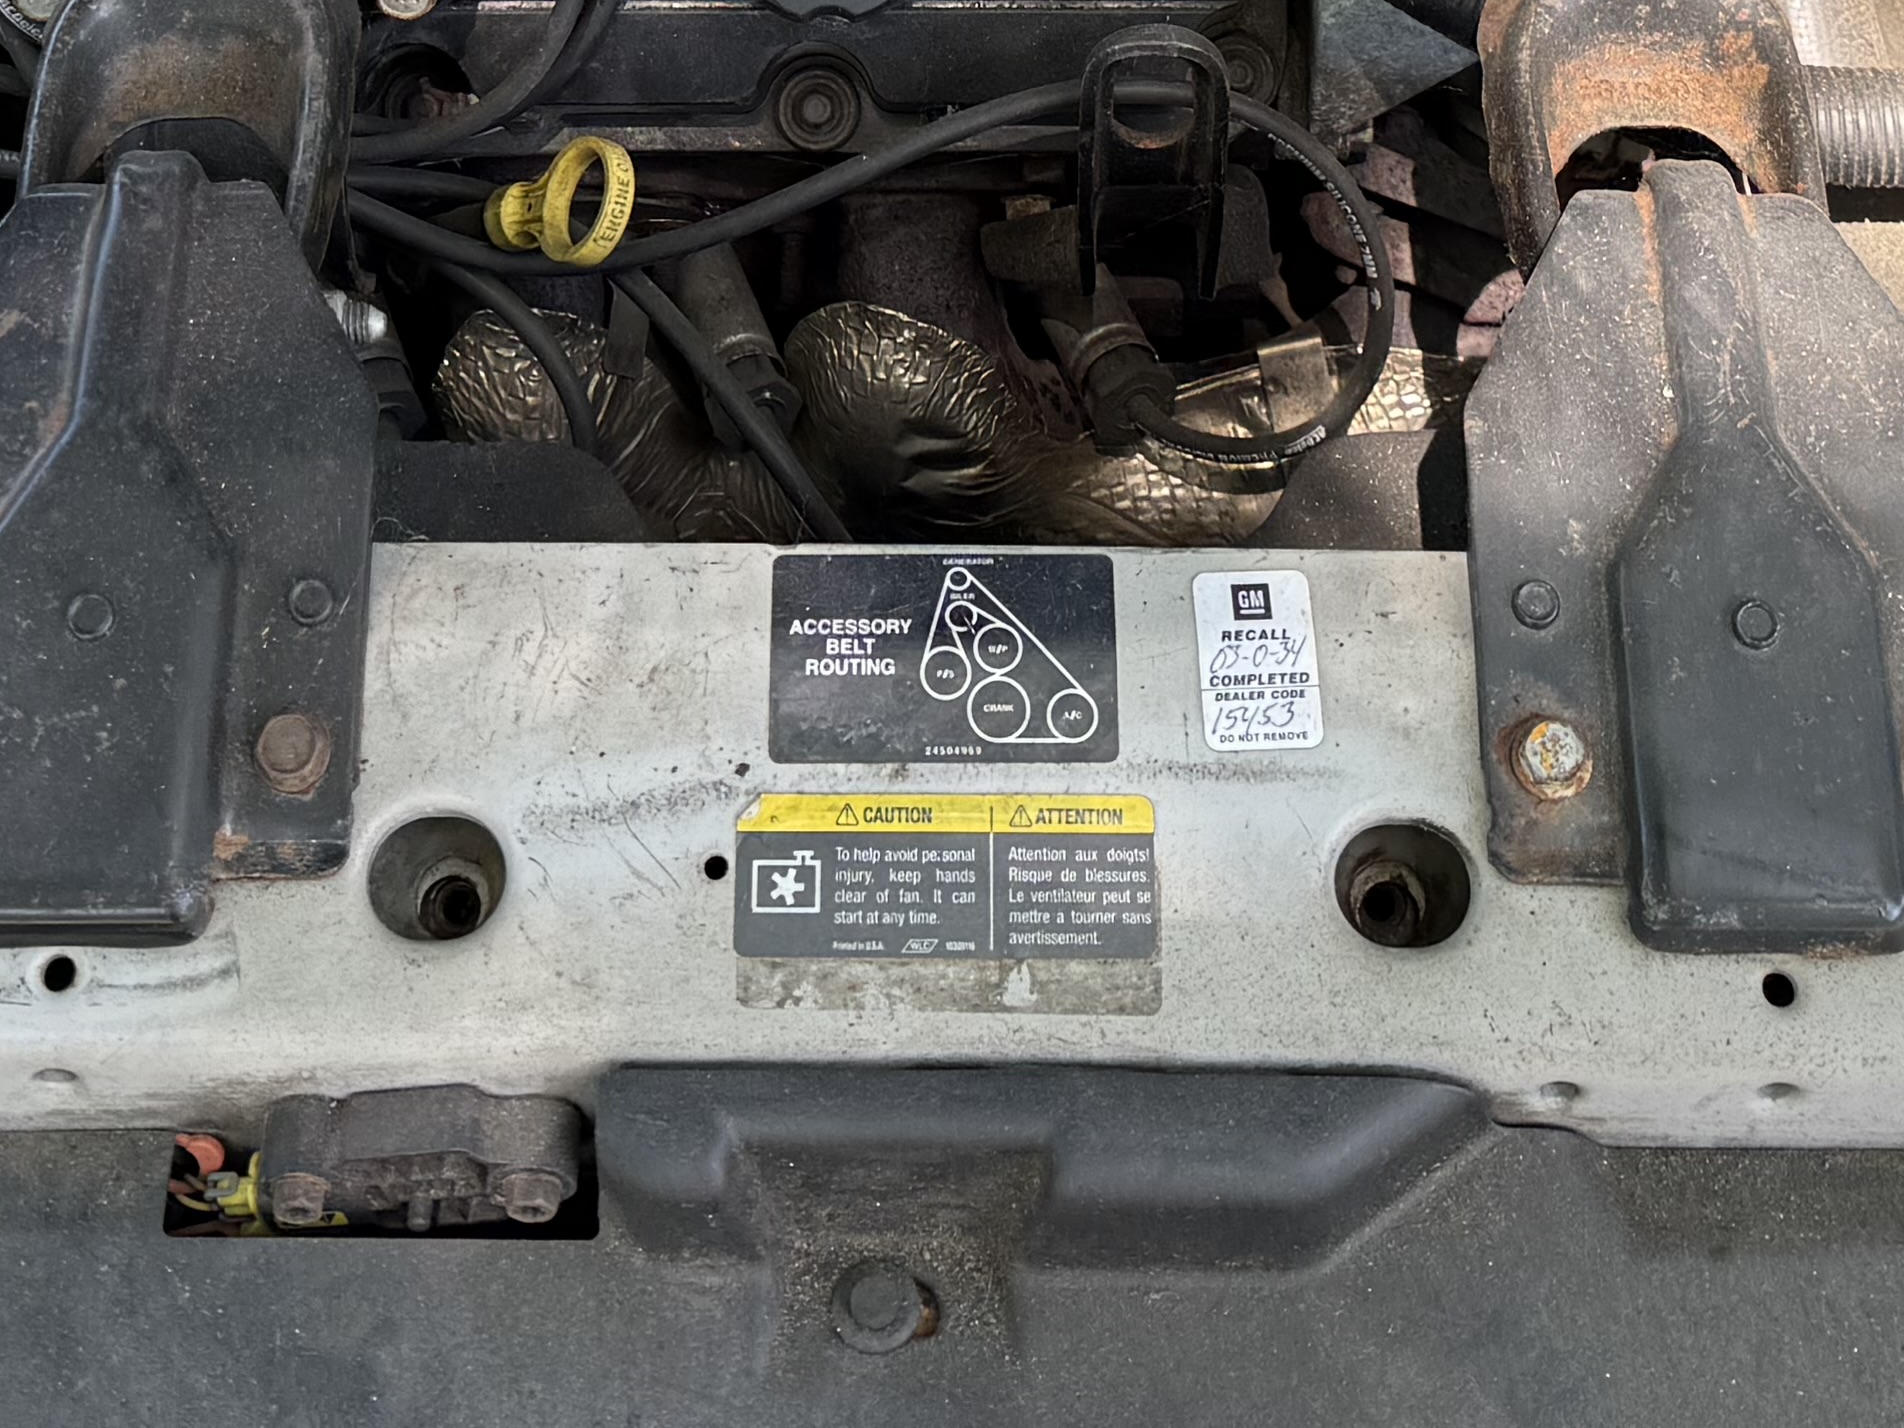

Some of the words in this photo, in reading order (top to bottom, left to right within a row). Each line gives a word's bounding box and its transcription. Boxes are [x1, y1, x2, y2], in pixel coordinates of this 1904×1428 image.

[598, 176, 631, 243] ENGINE
[942, 556, 995, 566] GENERATOR
[1237, 589, 1265, 609] GM
[789, 617, 912, 636] ACCESSORY
[1221, 628, 1291, 642] RECALL
[825, 637, 876, 656] BELT
[804, 657, 896, 677] ROUTING
[936, 669, 956, 679] P/S
[1209, 672, 1310, 687] COMPLETED
[1214, 690, 1266, 702] DEALER
[1270, 689, 1306, 700] CODE
[982, 703, 1015, 713] CRANK
[1062, 710, 1083, 720] A/C
[1219, 734, 1235, 744] DO
[1238, 733, 1260, 742] NOT
[1263, 730, 1309, 741] REMOVE
[863, 806, 933, 824] CAUTION
[1035, 807, 1123, 825] ATTENTION
[835, 846, 850, 862] To
[853, 847, 881, 865] help
[884, 847, 918, 862] avoid
[1008, 846, 1067, 862] Attention
[1075, 849, 1098, 862] aux
[1106, 847, 1150, 866] doigts!
[835, 867, 875, 886] injury,
[889, 868, 922, 886] keep
[935, 868, 976, 883] hands
[1008, 866, 1053, 885] Risque
[1060, 868, 1077, 883] de
[1085, 867, 1151, 883] blessures.
[834, 888, 867, 904] clear
[876, 888, 890, 904] of
[898, 888, 924, 904] fan.
[933, 888, 942, 904] It
[951, 890, 976, 904] can
[1008, 888, 1024, 903] Le
[1030, 888, 1096, 903] ventilateur
[1102, 889, 1131, 906] peut
[1136, 890, 1152, 903] se
[834, 909, 863, 924] start
[866, 910, 879, 924] at
[882, 912, 905, 927] any
[909, 910, 941, 925] time.
[1008, 908, 1051, 924] mettre
[1071, 909, 1116, 924] tourner
[1122, 911, 1152, 925] sans
[1008, 930, 1102, 945] avertissement.
